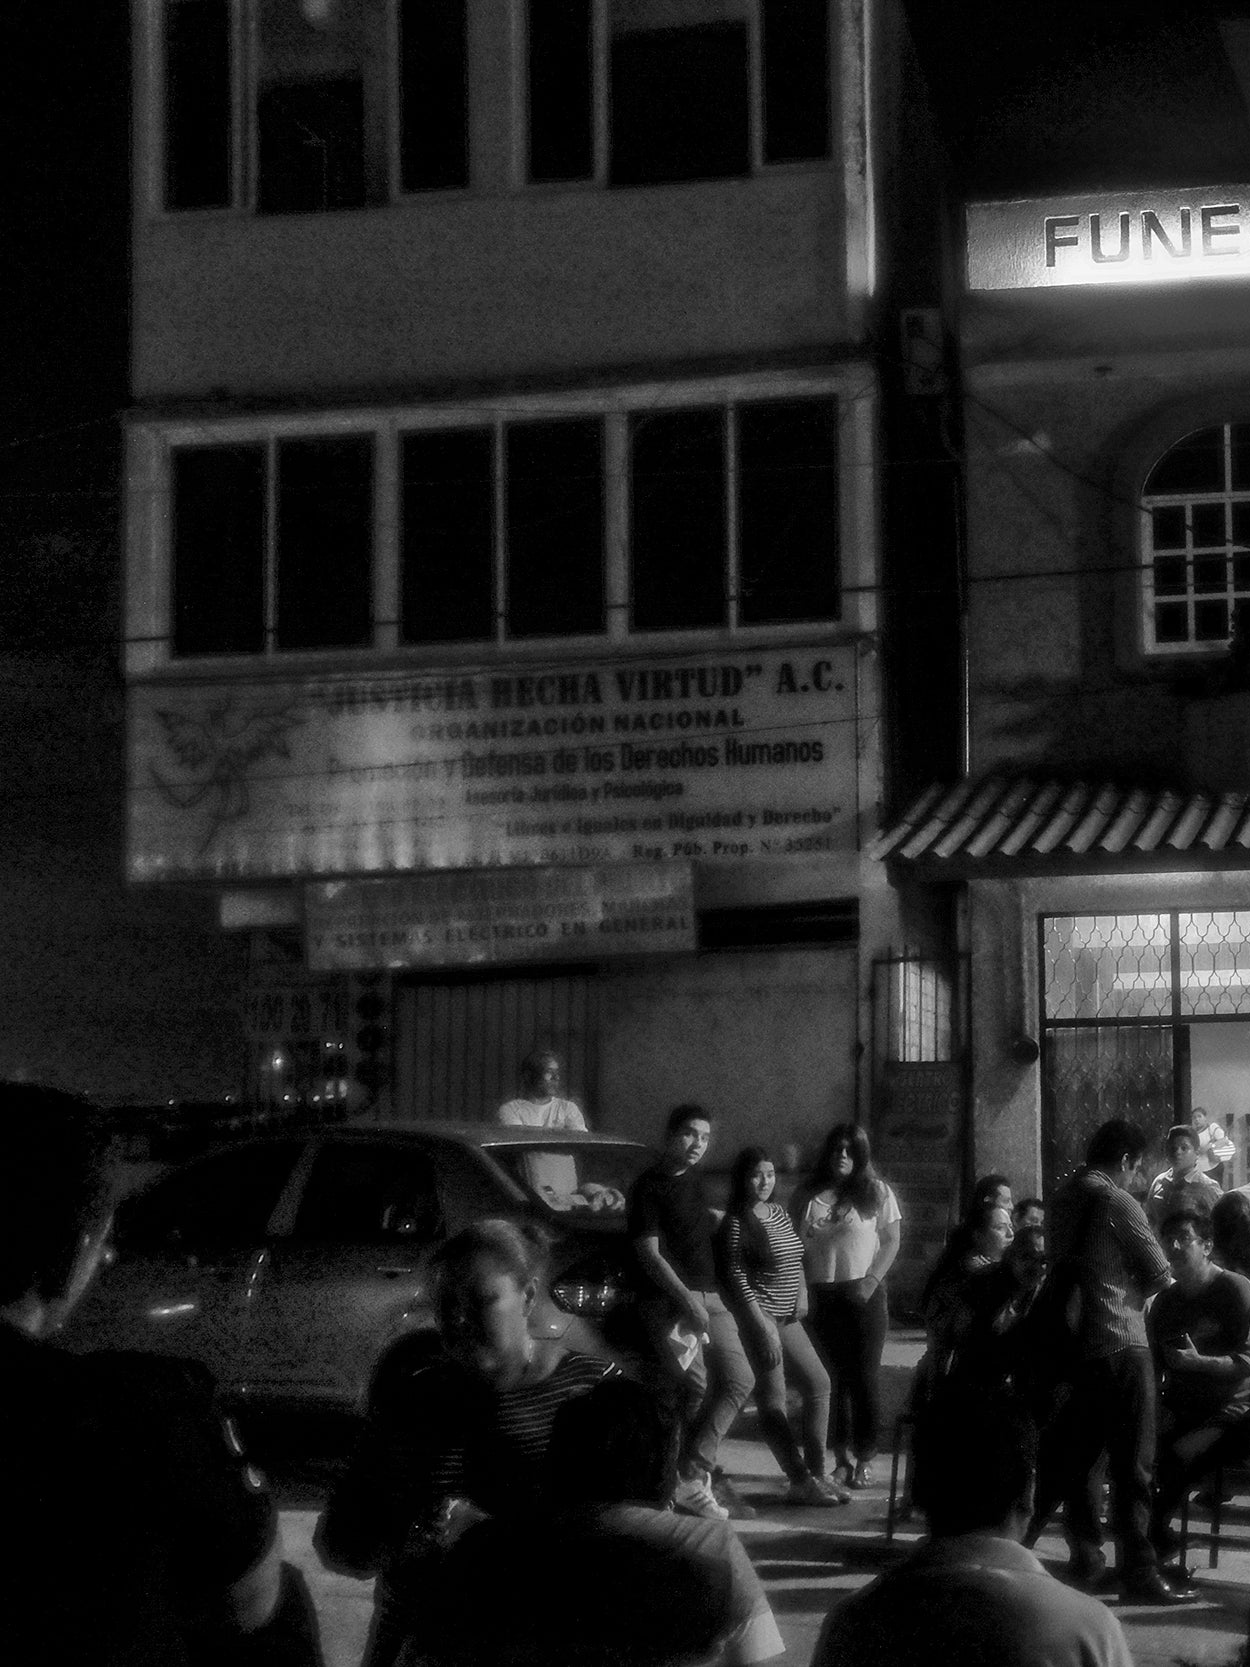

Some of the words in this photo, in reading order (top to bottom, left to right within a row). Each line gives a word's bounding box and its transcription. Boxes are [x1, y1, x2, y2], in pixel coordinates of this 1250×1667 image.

[490, 671, 604, 708] HECHA
[776, 660, 845, 694] A.C.
[410, 712, 605, 740] ORGANIZACIÓN
[614, 708, 745, 732] NACIONAL
[461, 749, 546, 778] Defensa
[552, 748, 577, 774] de
[584, 746, 614, 771] los
[620, 740, 719, 772] Derechos
[724, 738, 824, 766] Humanos
[561, 921, 586, 937] EN
[598, 915, 691, 934] GENERAL
